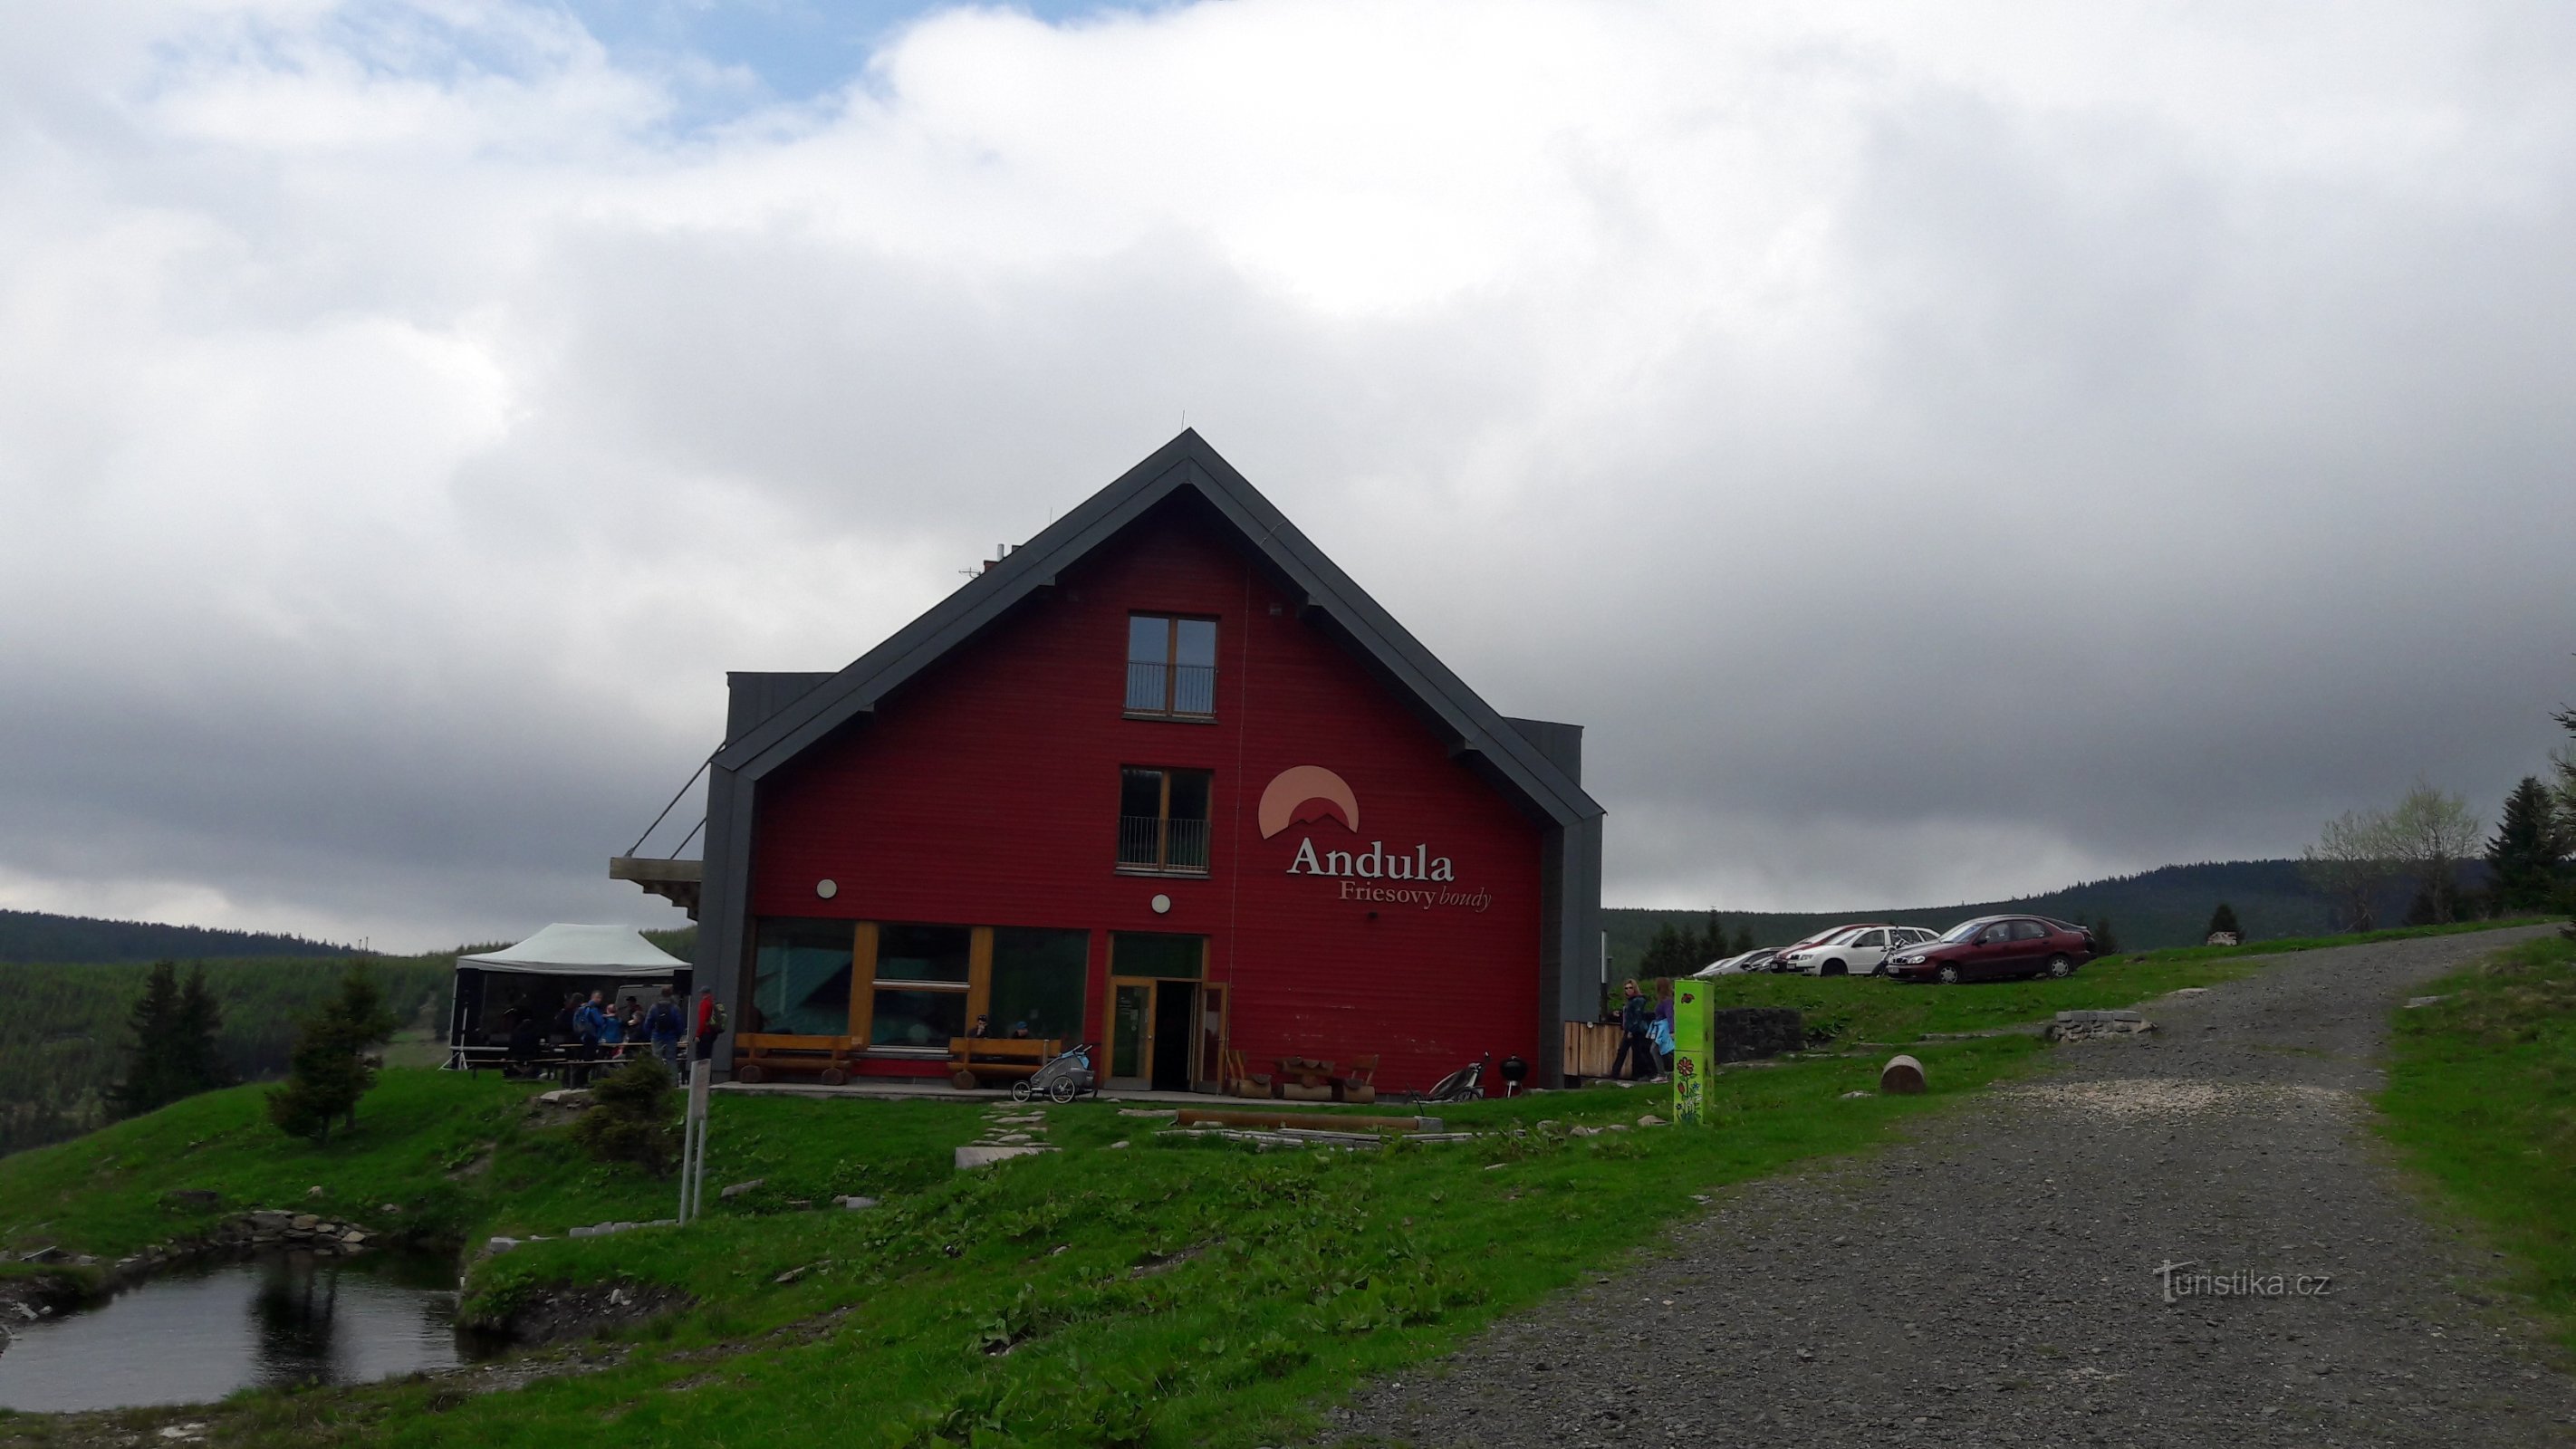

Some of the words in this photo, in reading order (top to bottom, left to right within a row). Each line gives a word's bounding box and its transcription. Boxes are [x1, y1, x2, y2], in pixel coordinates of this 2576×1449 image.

[1286, 837, 1455, 882] Andula
[1338, 880, 1437, 910] Friesovy
[1439, 885, 1492, 913] boudy
